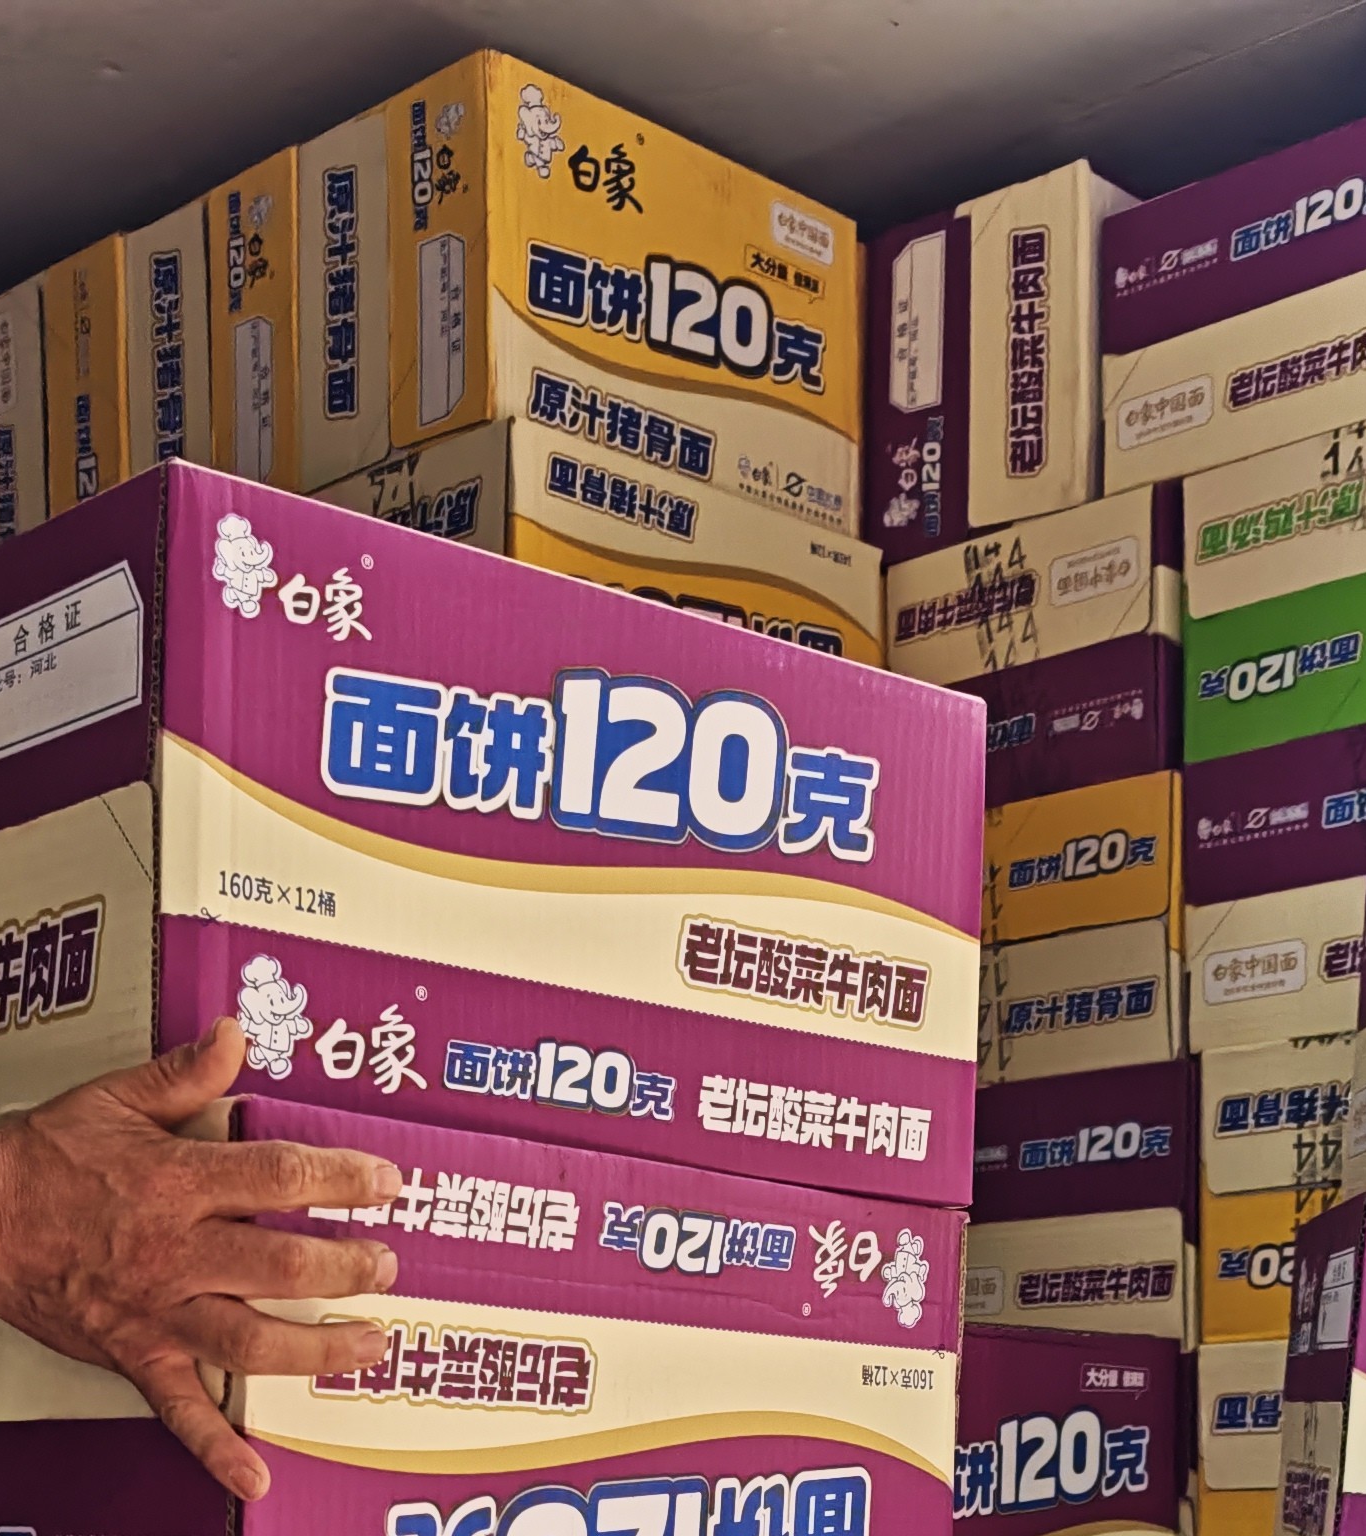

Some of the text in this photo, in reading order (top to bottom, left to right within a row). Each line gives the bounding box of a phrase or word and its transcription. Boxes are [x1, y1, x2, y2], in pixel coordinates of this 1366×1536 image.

[410, 100, 434, 232] 面饼120克
[435, 145, 463, 204] 白象
[568, 143, 644, 214] 白象
[323, 165, 358, 420] 原汁猪骨面
[526, 239, 826, 394] 面饼120克
[1006, 225, 1050, 478] 老坛酸菜牛肉面
[529, 367, 717, 482] 原汁猪骨面
[1125, 385, 1206, 428] 白象中国面
[546, 452, 698, 542] 原汁猪骨面
[1195, 474, 1366, 566] 原汁鸡汤面
[12, 600, 84, 658] 合格证
[278, 567, 374, 642] 白象
[1198, 632, 1364, 703] 面饼120克
[320, 667, 882, 863] 面饼120克
[218, 868, 338, 919] 160克×12桶
[1008, 829, 1158, 891] 面饼120克
[676, 914, 934, 1032] 老坛酸菜牛肉面
[1212, 949, 1298, 984] 白象中国面
[1006, 978, 1159, 1035] 原汁猪骨面
[314, 1003, 934, 1163] 白象 面饼120克 老坛酸菜牛肉面
[1019, 1121, 1173, 1171] 面饼120克
[598, 1200, 797, 1277] 面饼120克
[807, 1219, 885, 1298] 白象
[1015, 1260, 1177, 1308] 老坛酸菜牛肉面
[861, 1362, 935, 1390] 160克×12桶
